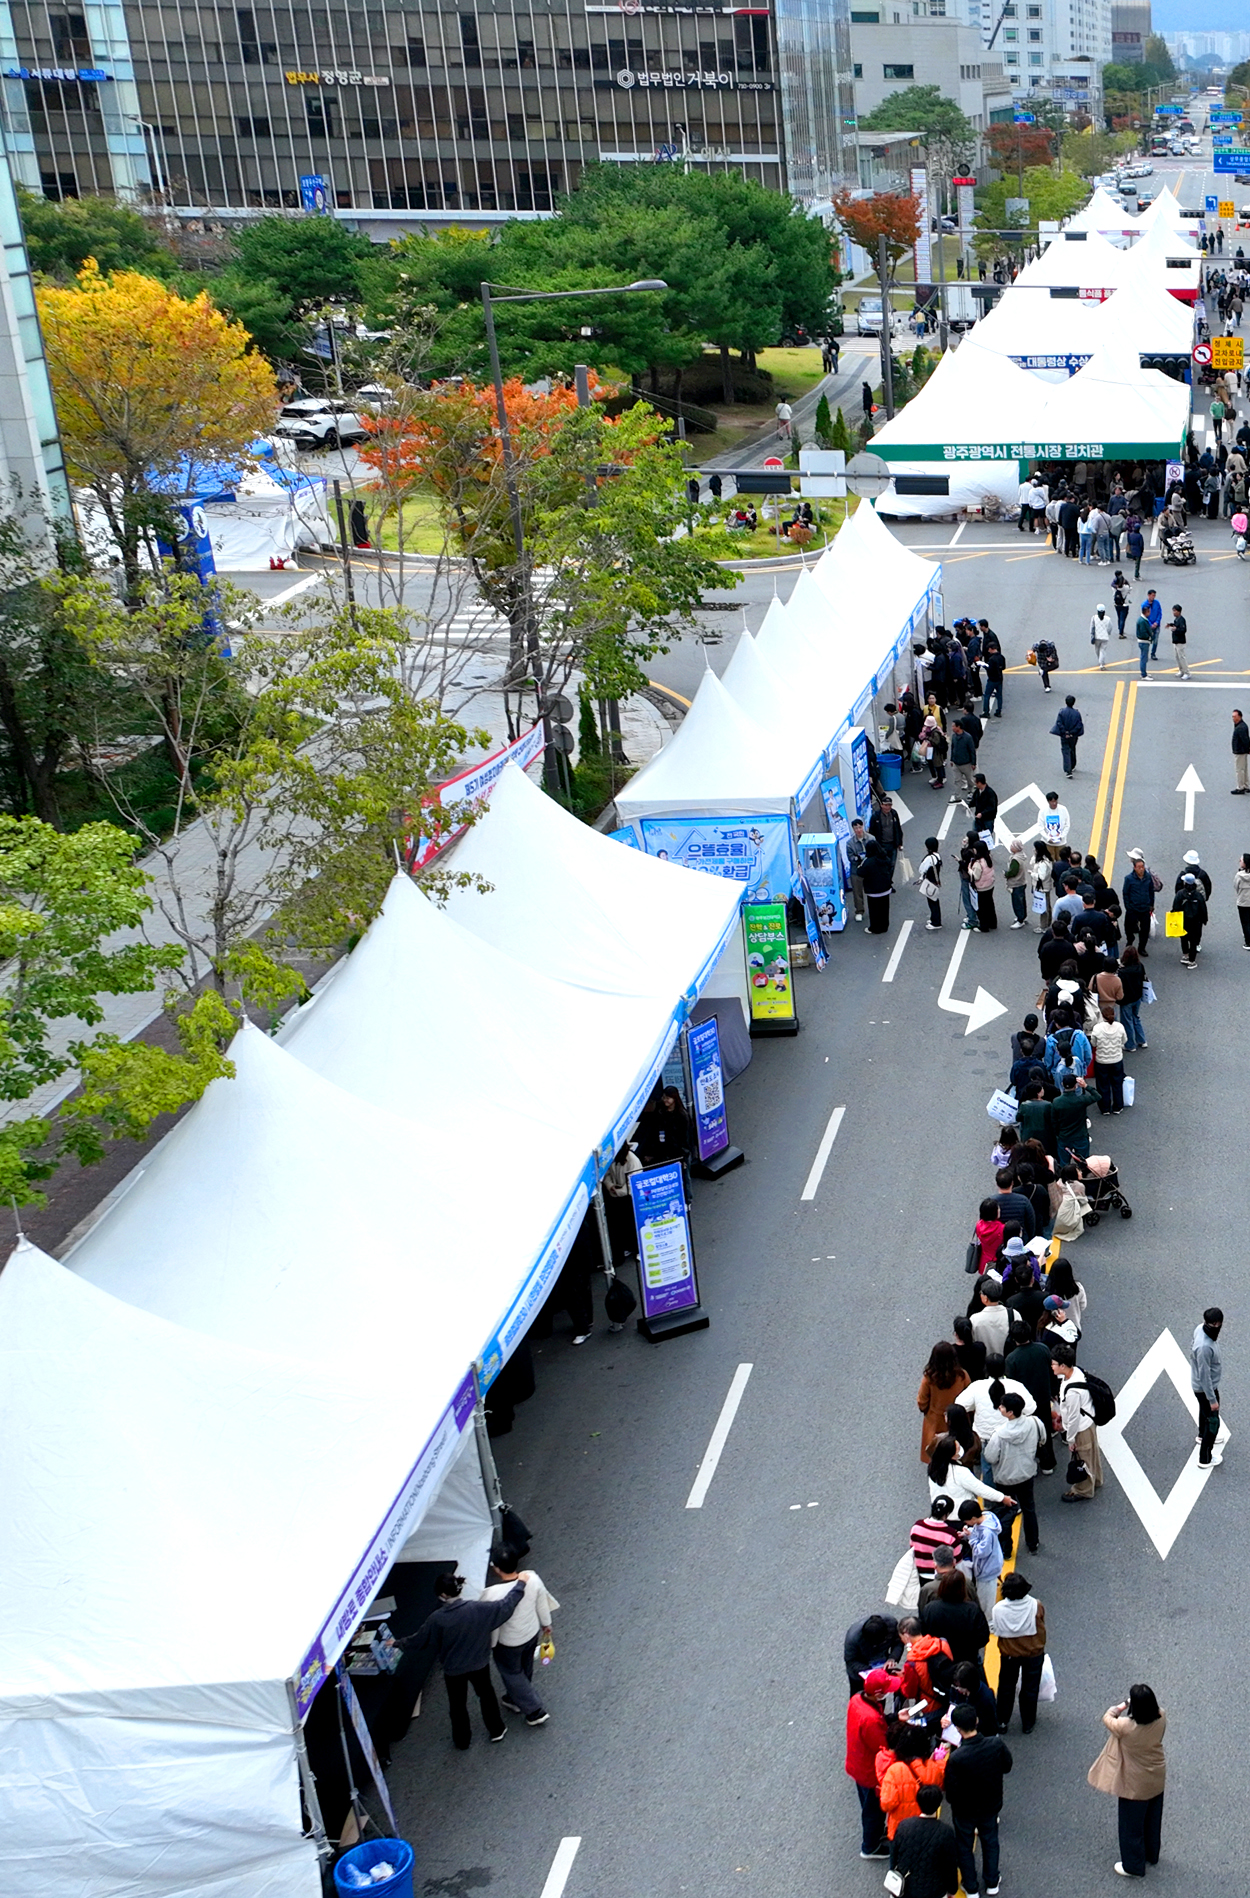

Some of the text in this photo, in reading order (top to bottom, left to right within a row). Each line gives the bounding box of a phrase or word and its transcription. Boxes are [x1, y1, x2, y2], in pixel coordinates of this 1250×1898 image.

[285, 71, 319, 85] 법무사
[637, 70, 734, 90] 법무법인 거북이
[1026, 356, 1067, 368] 대통령상
[1068, 355, 1089, 367] 수상
[1214, 358, 1243, 366] 진입금지
[943, 444, 1104, 460] 광주광역시 전통시장 김치관
[687, 843, 744, 857] 으뜸효율
[722, 865, 748, 878] 환급
[768, 922, 782, 931] 진로
[748, 931, 786, 943] 상담부스
[635, 1170, 678, 1190] 글로컬대학30
[354, 1547, 389, 1608] 종합안내소
